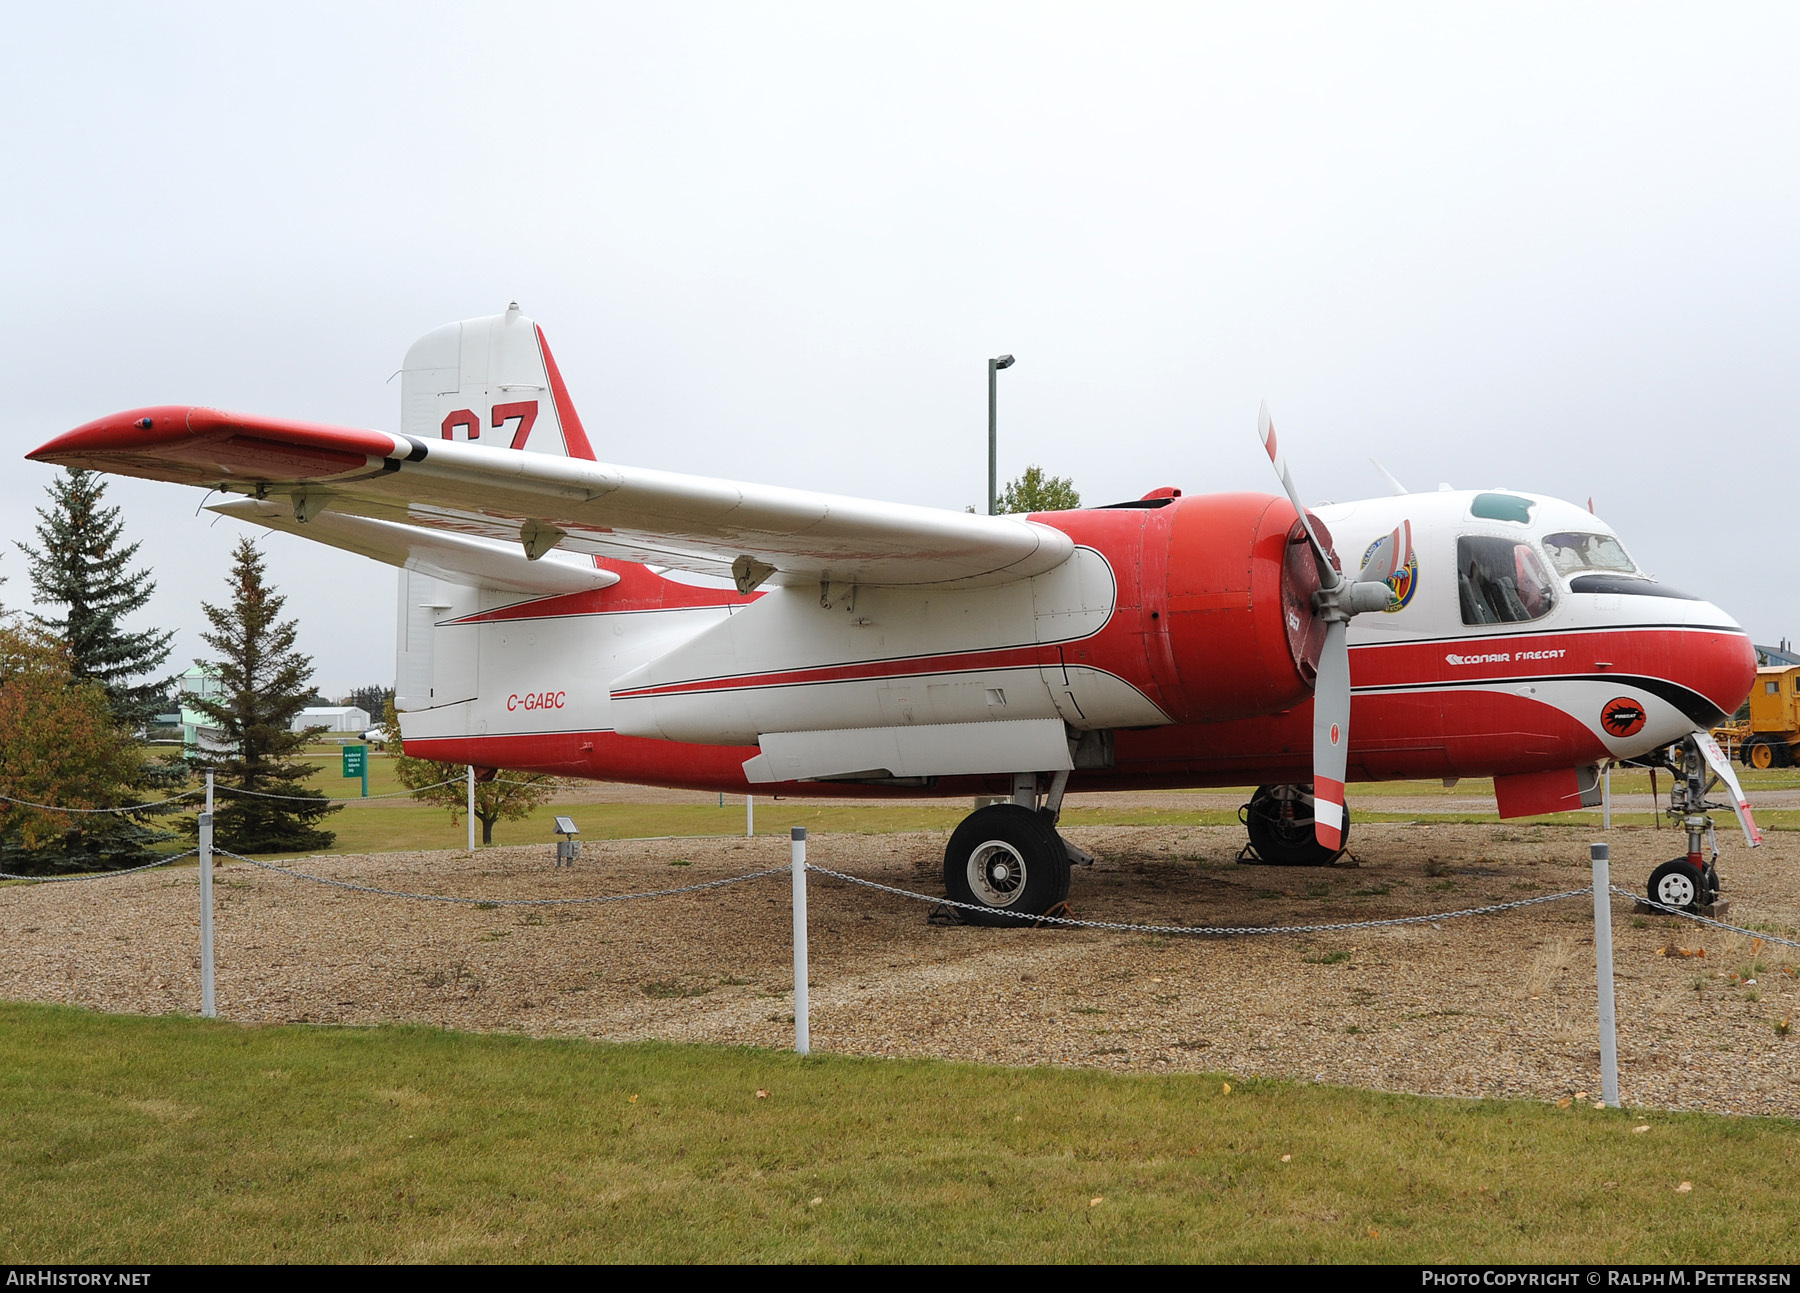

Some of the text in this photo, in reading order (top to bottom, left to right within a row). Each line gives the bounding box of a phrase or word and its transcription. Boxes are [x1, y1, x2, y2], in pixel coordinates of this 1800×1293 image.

[1464, 649, 1566, 665] CONAIR FIRECAT
[506, 690, 566, 712] C-GABC
